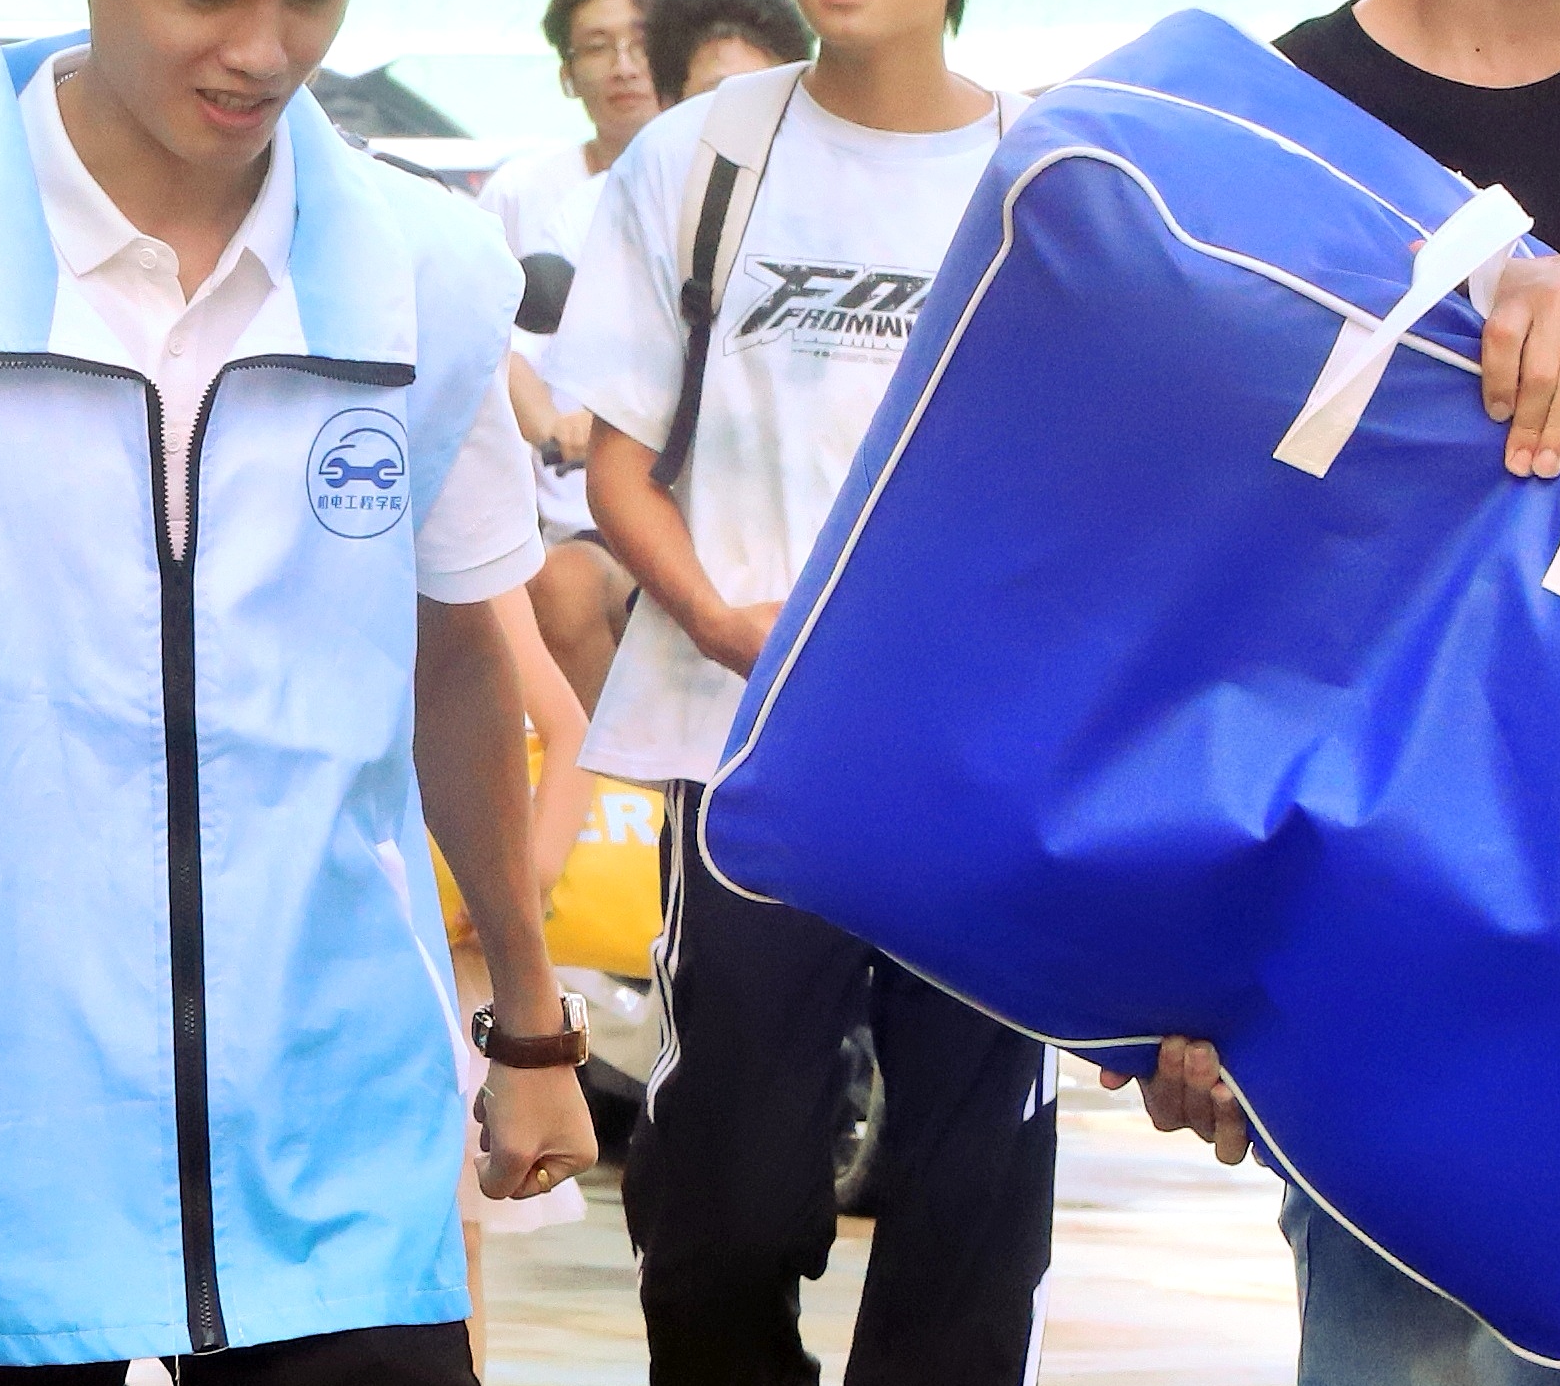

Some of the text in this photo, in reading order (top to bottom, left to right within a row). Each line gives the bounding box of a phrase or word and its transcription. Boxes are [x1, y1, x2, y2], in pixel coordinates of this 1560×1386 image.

[317, 495, 402, 510] 机电工程学院
